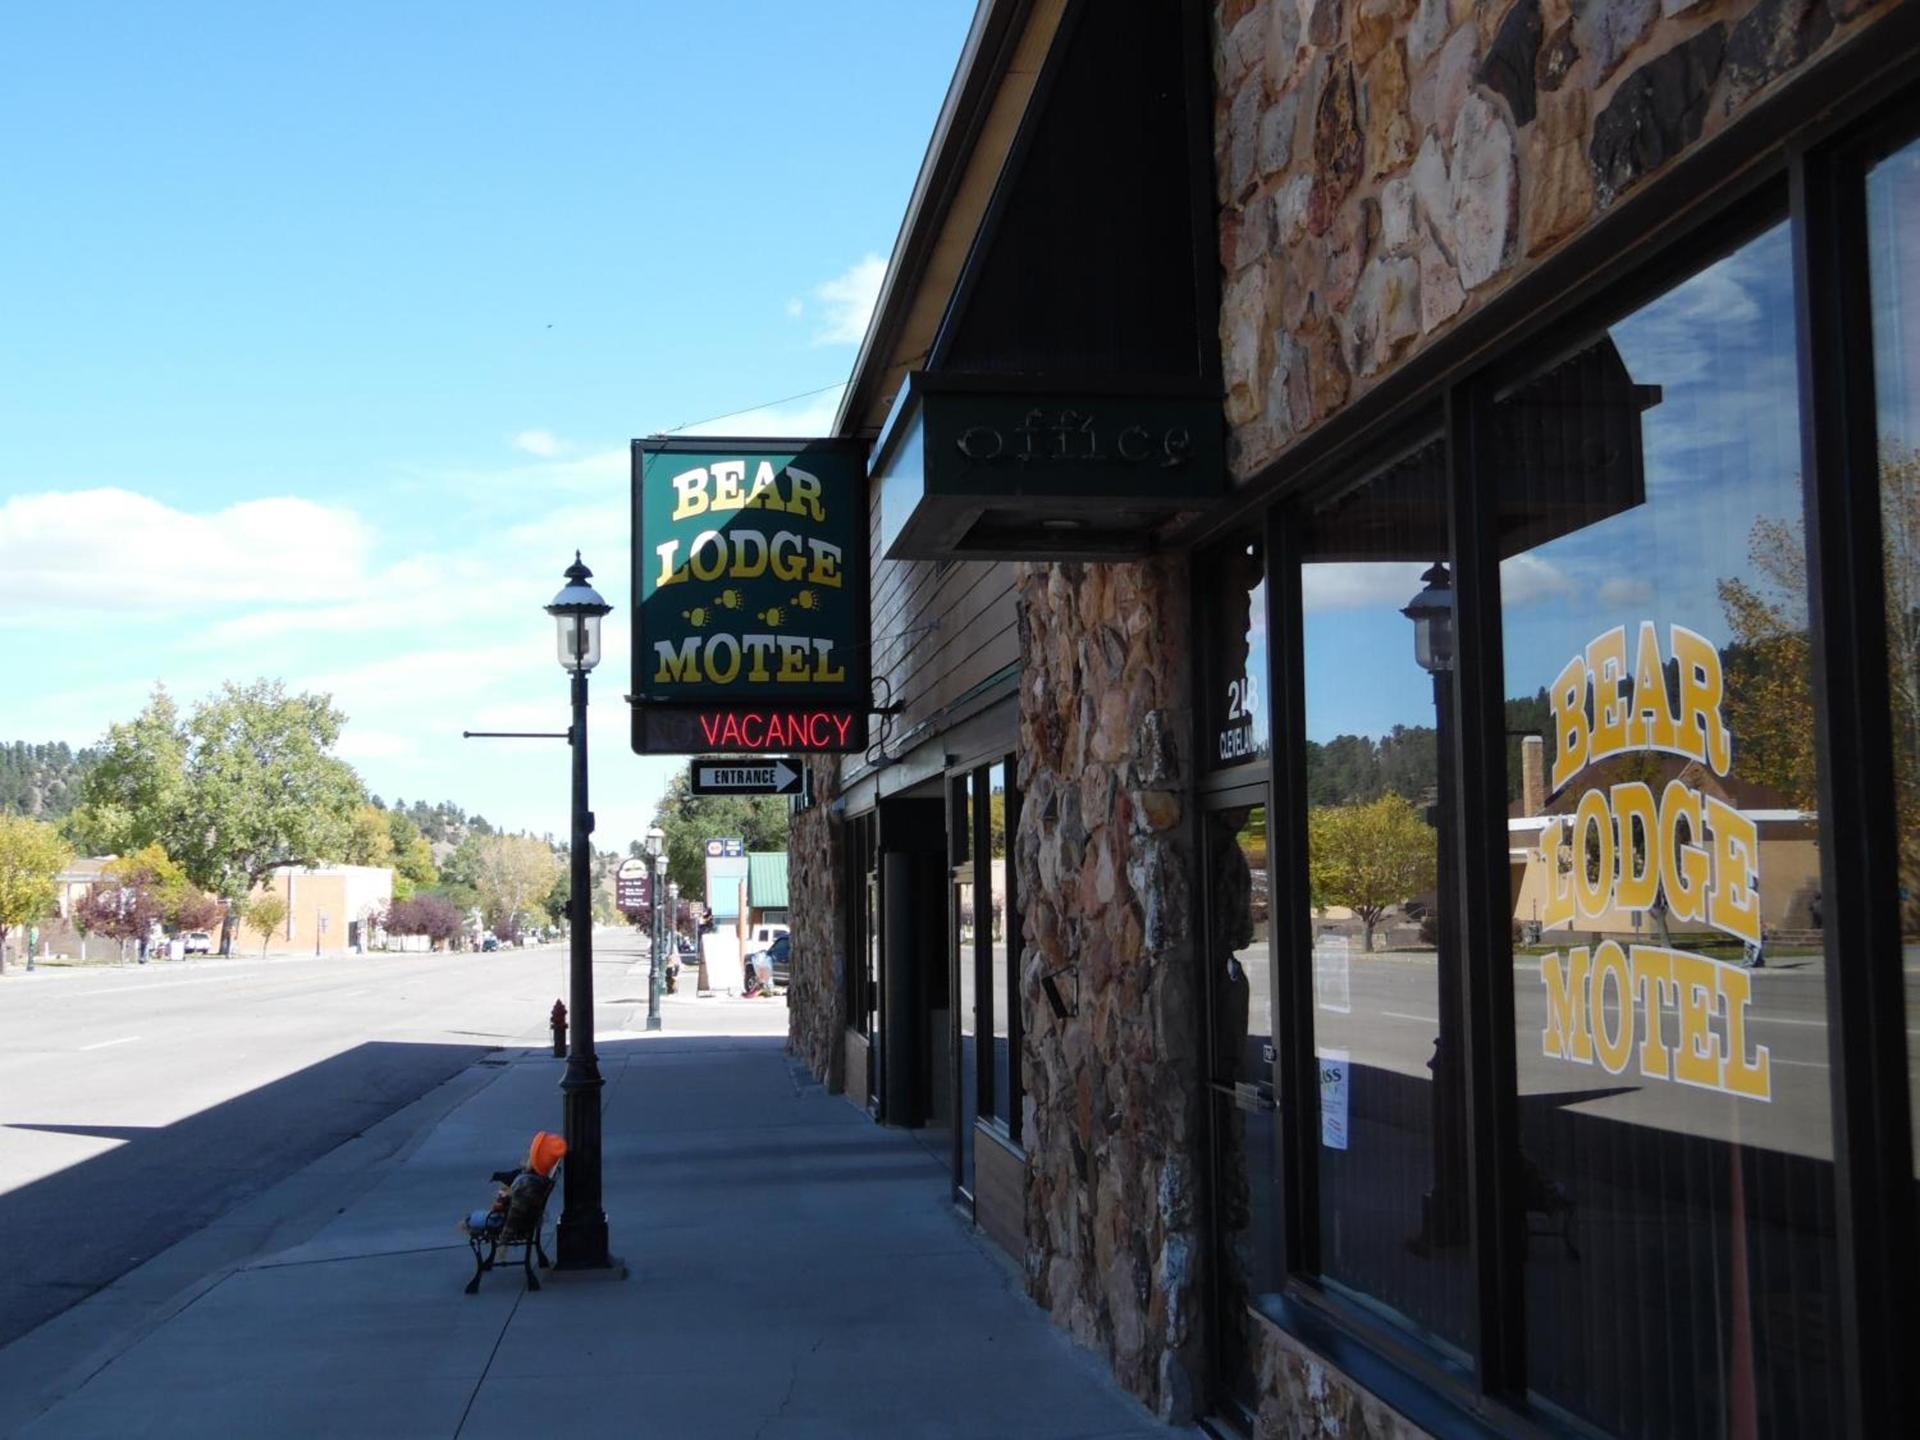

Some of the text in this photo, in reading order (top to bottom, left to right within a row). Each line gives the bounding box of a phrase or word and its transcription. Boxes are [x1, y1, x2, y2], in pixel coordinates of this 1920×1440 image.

[672, 460, 826, 522] BEAR
[656, 529, 842, 588] LODGE
[654, 632, 845, 684] MOTEL
[1228, 675, 1259, 720] 218
[1549, 620, 1731, 794] BEAR
[700, 713, 852, 748] VACANCY
[714, 769, 776, 785] ENTRANCE
[1541, 780, 1761, 946] LODGE
[1539, 940, 1772, 1102] MOTEL
